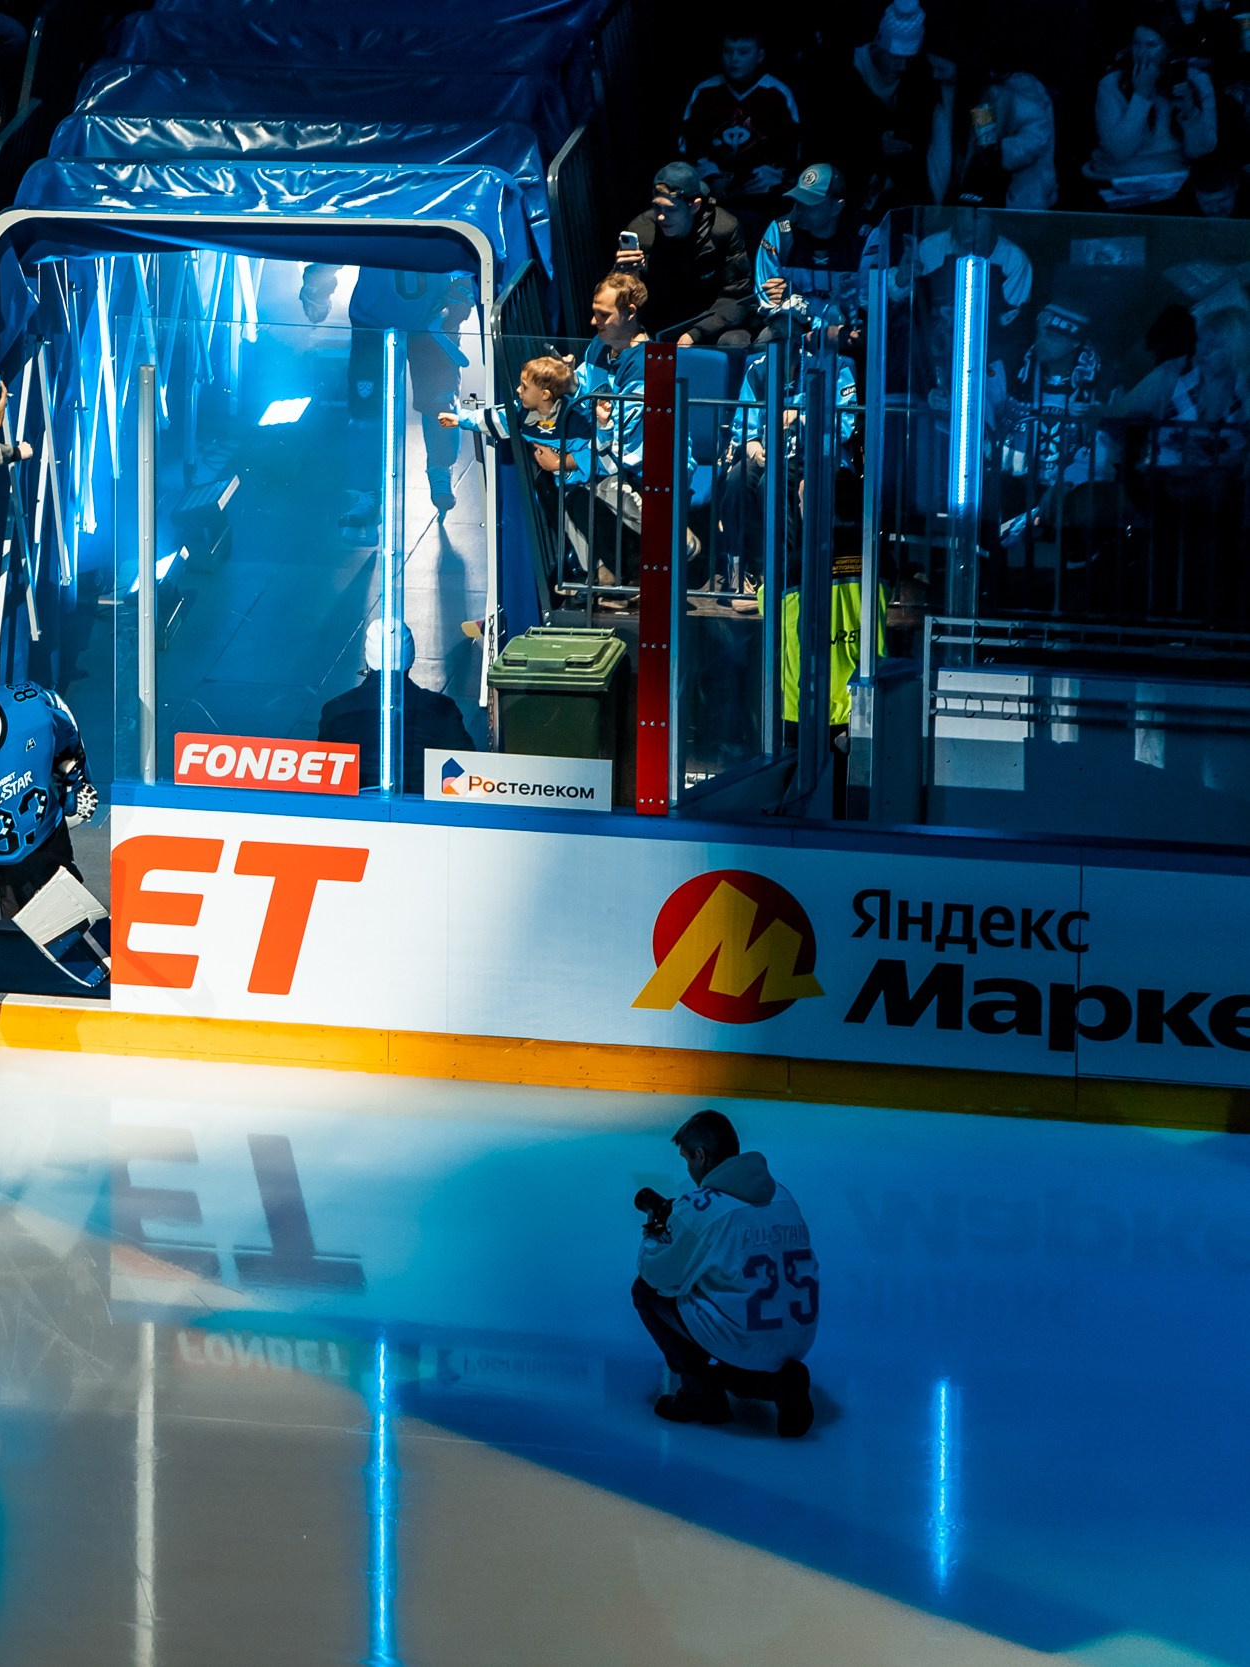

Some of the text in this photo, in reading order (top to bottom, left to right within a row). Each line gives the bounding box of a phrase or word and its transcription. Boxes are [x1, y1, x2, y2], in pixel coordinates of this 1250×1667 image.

[178, 743, 356, 786] FONBET
[468, 776, 594, 800] Ростелеком
[851, 889, 1090, 954] Яндекс
[742, 1249, 819, 1332] 25
